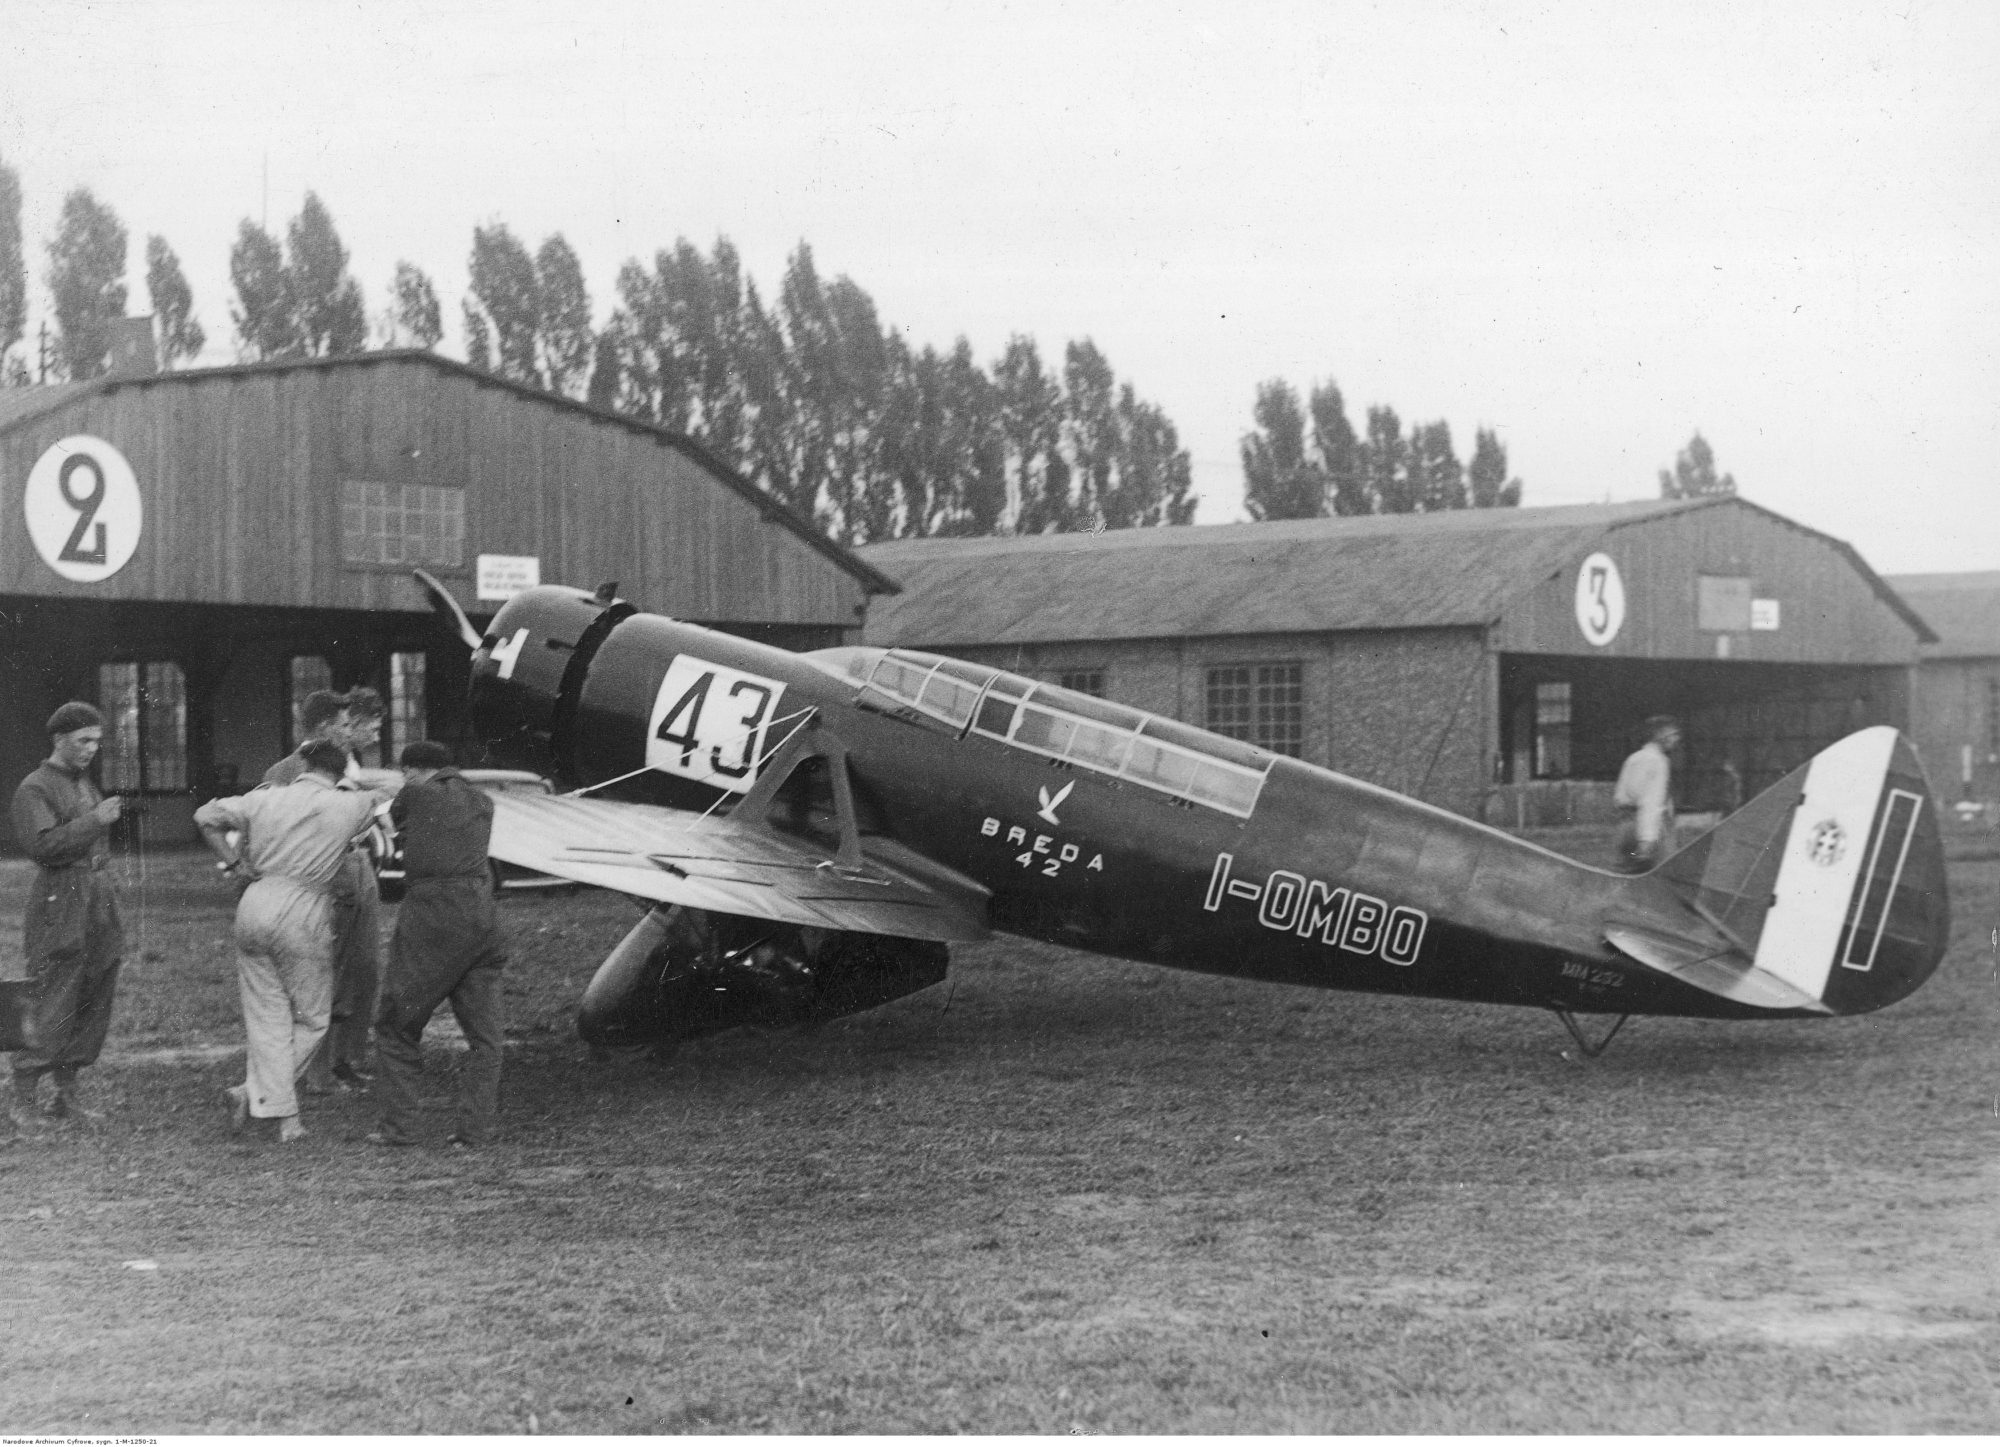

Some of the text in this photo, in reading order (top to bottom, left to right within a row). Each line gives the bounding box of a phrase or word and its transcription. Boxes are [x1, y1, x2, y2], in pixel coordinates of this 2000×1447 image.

[59, 453, 106, 564] 2
[1589, 567, 1609, 634] 3
[657, 671, 772, 779] 43
[981, 817, 1103, 872] BREDA
[1016, 851, 1061, 877] 42
[1203, 852, 1428, 966] I-OMBO
